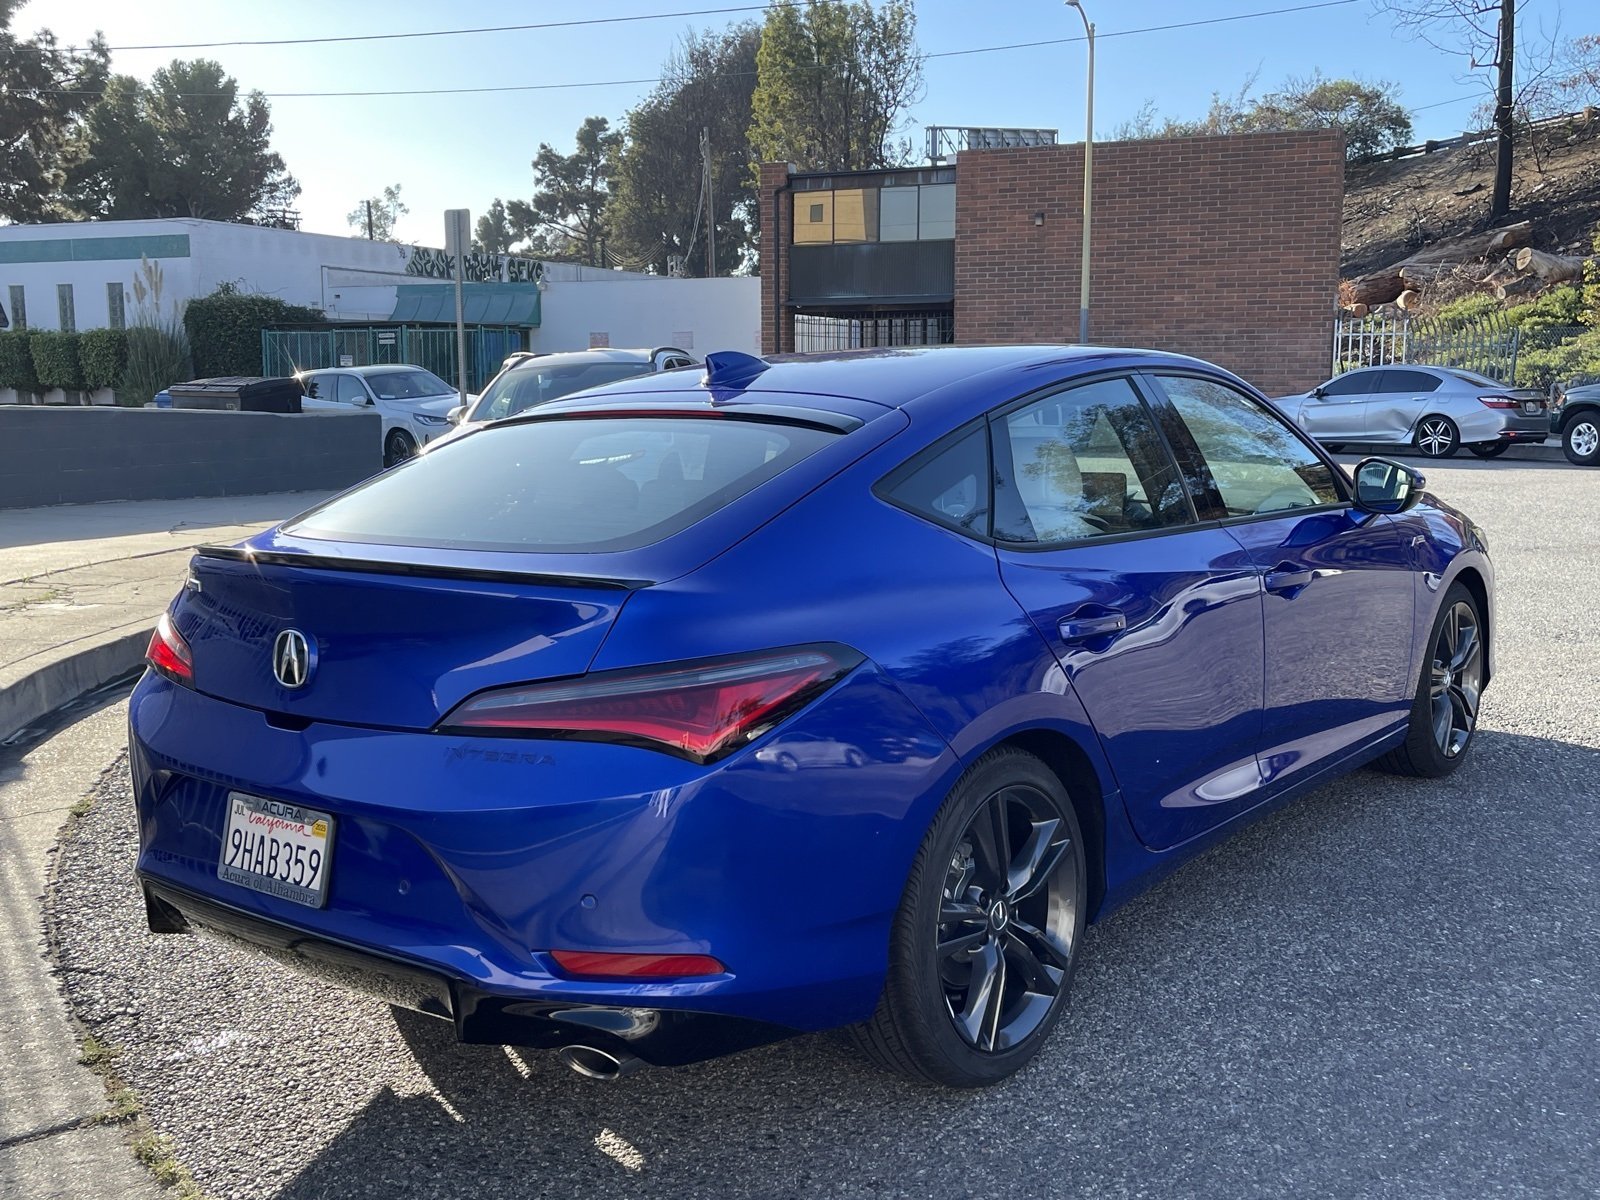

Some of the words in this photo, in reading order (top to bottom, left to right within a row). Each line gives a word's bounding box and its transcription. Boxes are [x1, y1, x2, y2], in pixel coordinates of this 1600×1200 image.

[248, 811, 312, 837] California
[260, 801, 303, 822] ACURA
[228, 828, 322, 889] 9HAB359
[222, 867, 250, 886] Acura
[253, 878, 262, 891] of
[264, 883, 316, 904] Alhambra
